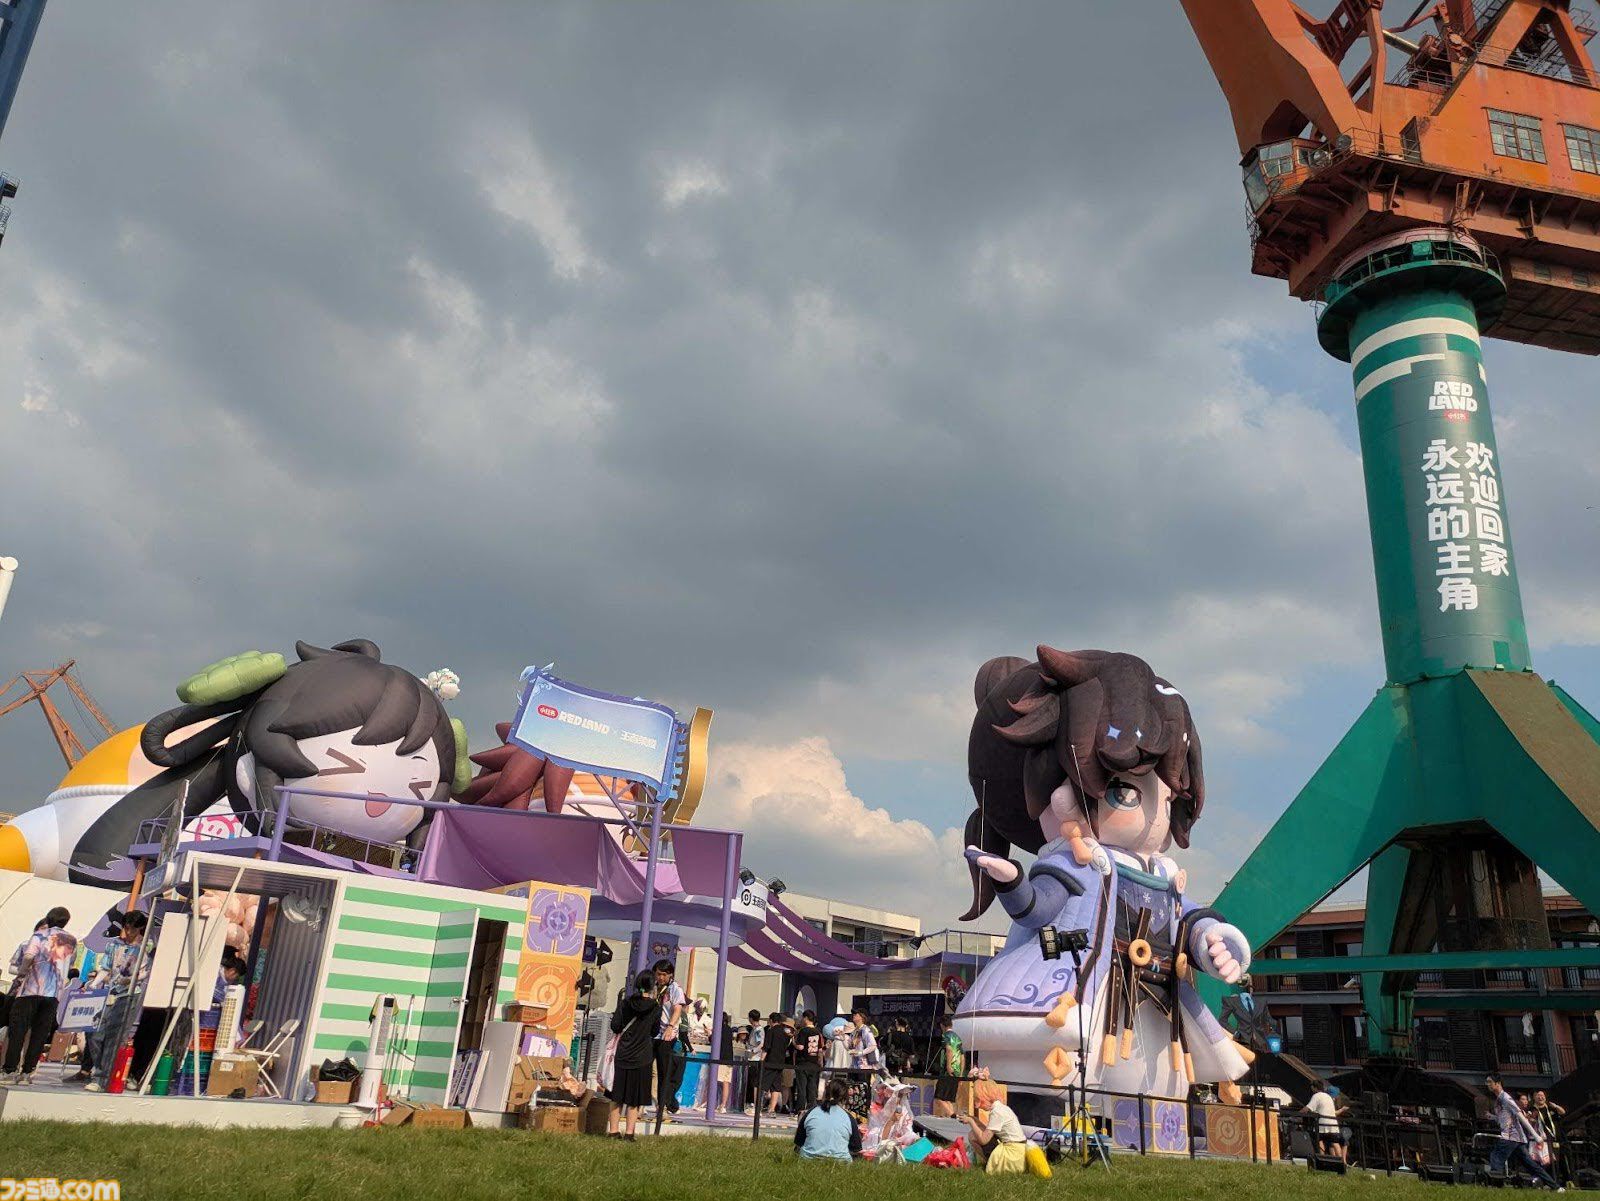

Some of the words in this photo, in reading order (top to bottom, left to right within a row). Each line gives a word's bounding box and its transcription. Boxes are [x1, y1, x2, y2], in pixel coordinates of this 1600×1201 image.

[1428, 395, 1478, 412] LAND
[1433, 381, 1473, 396] RED
[1421, 439, 1479, 613] 永远的主角
[1464, 441, 1510, 577] 欢迎回家
